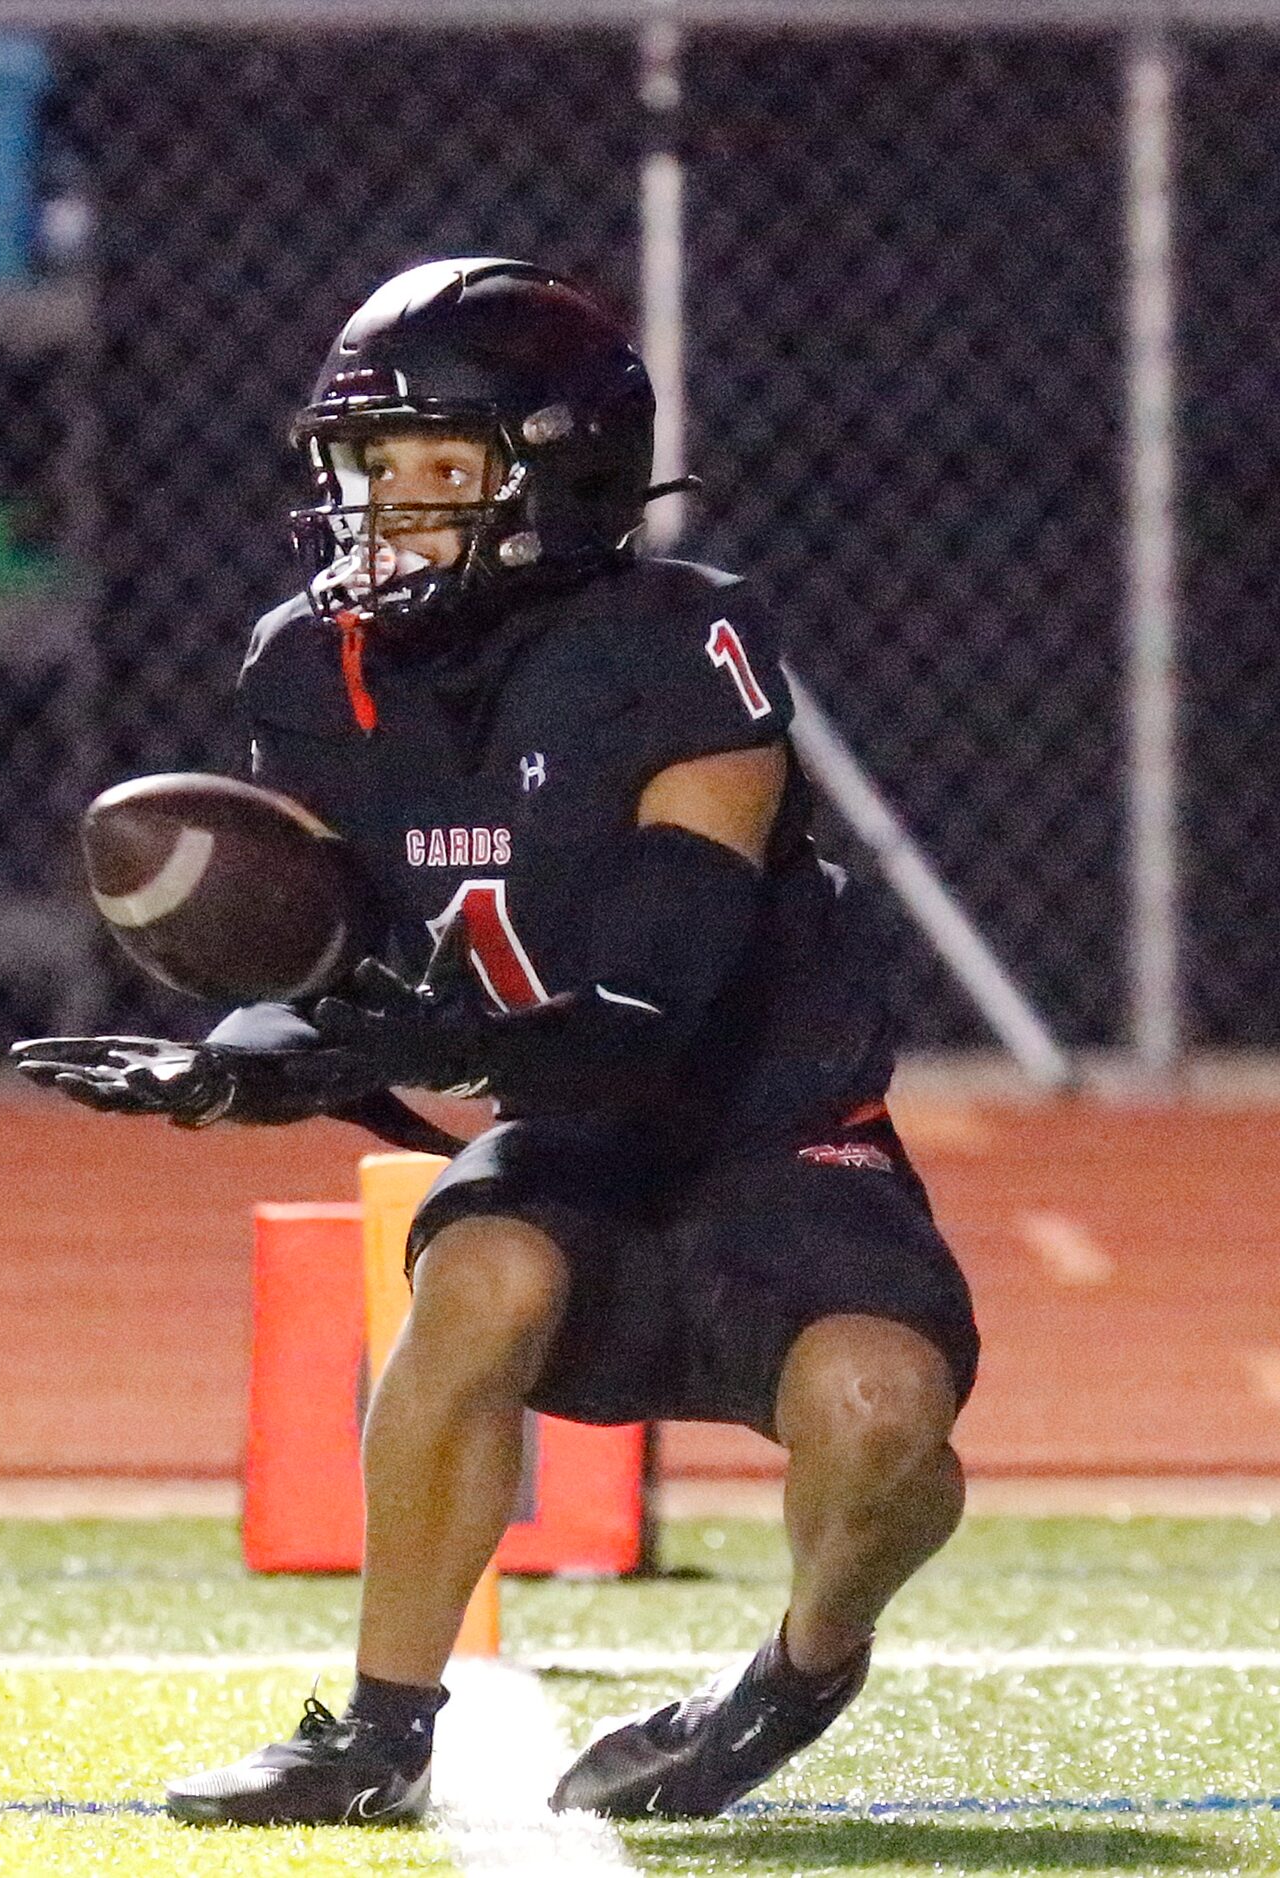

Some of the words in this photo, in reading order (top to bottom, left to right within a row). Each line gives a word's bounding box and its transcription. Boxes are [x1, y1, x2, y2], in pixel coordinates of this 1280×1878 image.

[705, 618, 772, 720] 1
[406, 828, 512, 867] CARDS
[424, 879, 552, 1014] 1
